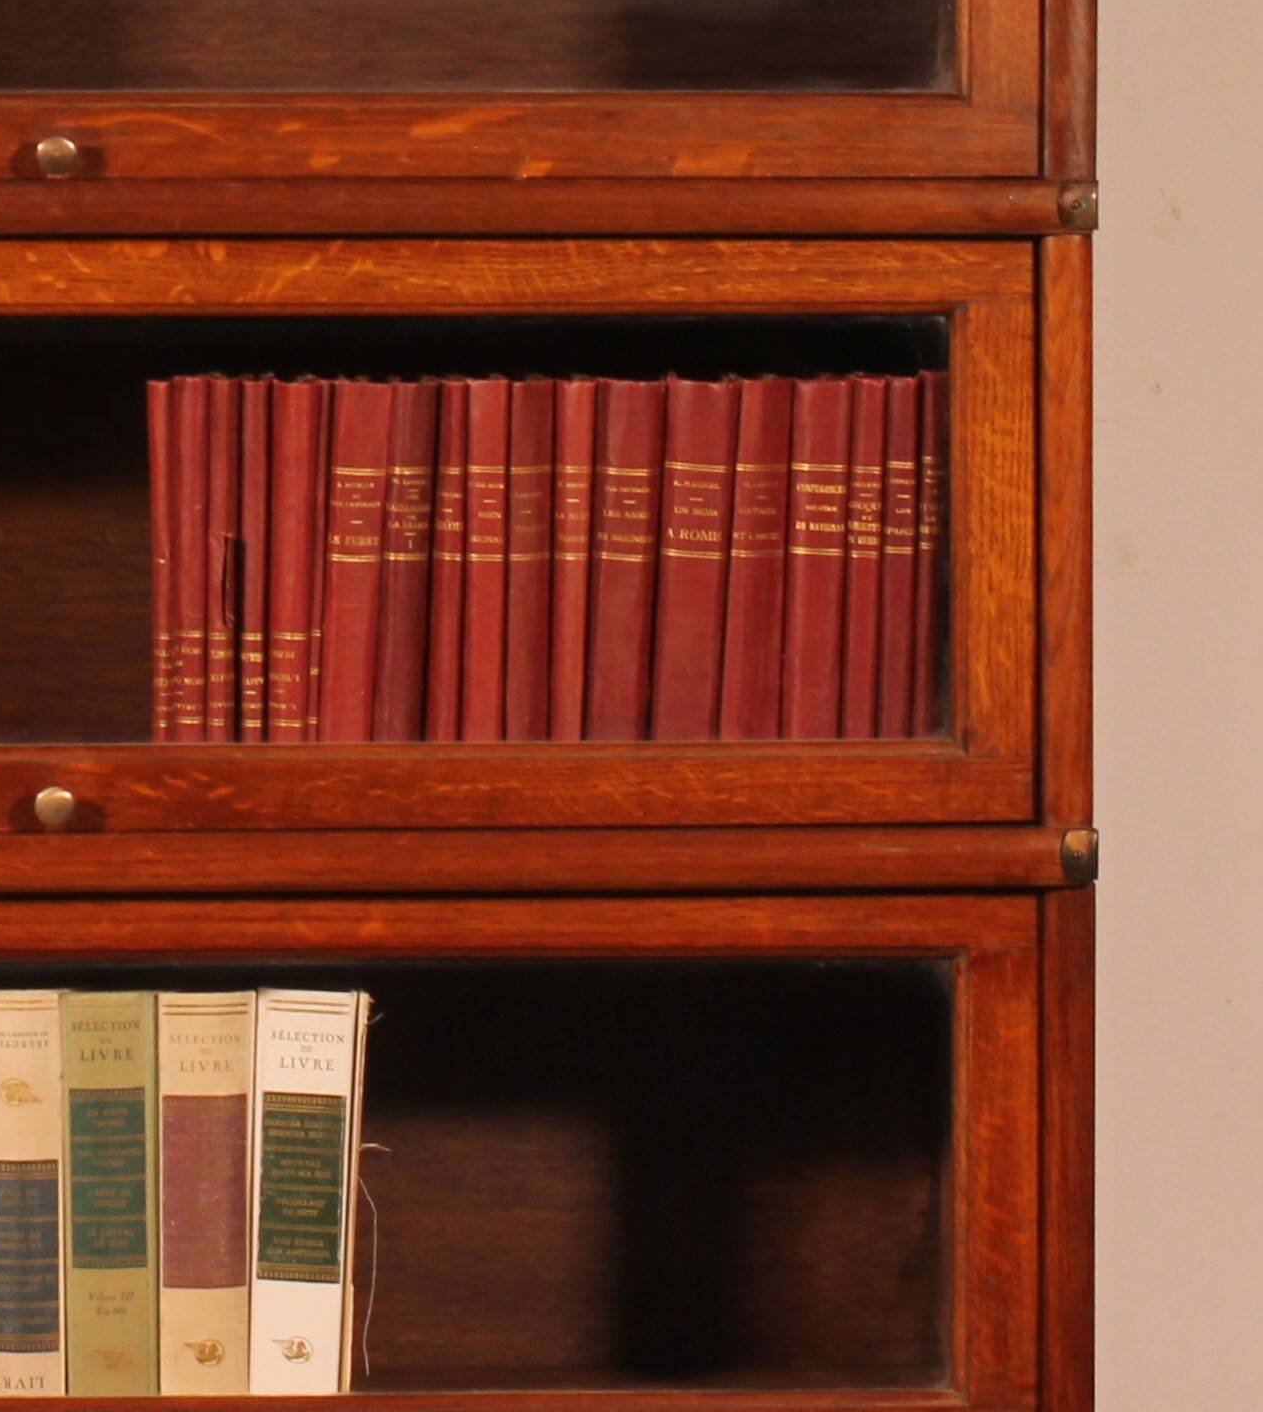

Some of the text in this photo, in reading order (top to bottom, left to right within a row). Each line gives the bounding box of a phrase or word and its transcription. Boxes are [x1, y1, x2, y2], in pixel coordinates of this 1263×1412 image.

[679, 529, 723, 542] ROME
[79, 1048, 135, 1062] LIVRE
[179, 1059, 234, 1073] LIVRE
[280, 1056, 335, 1071] LIVRE
